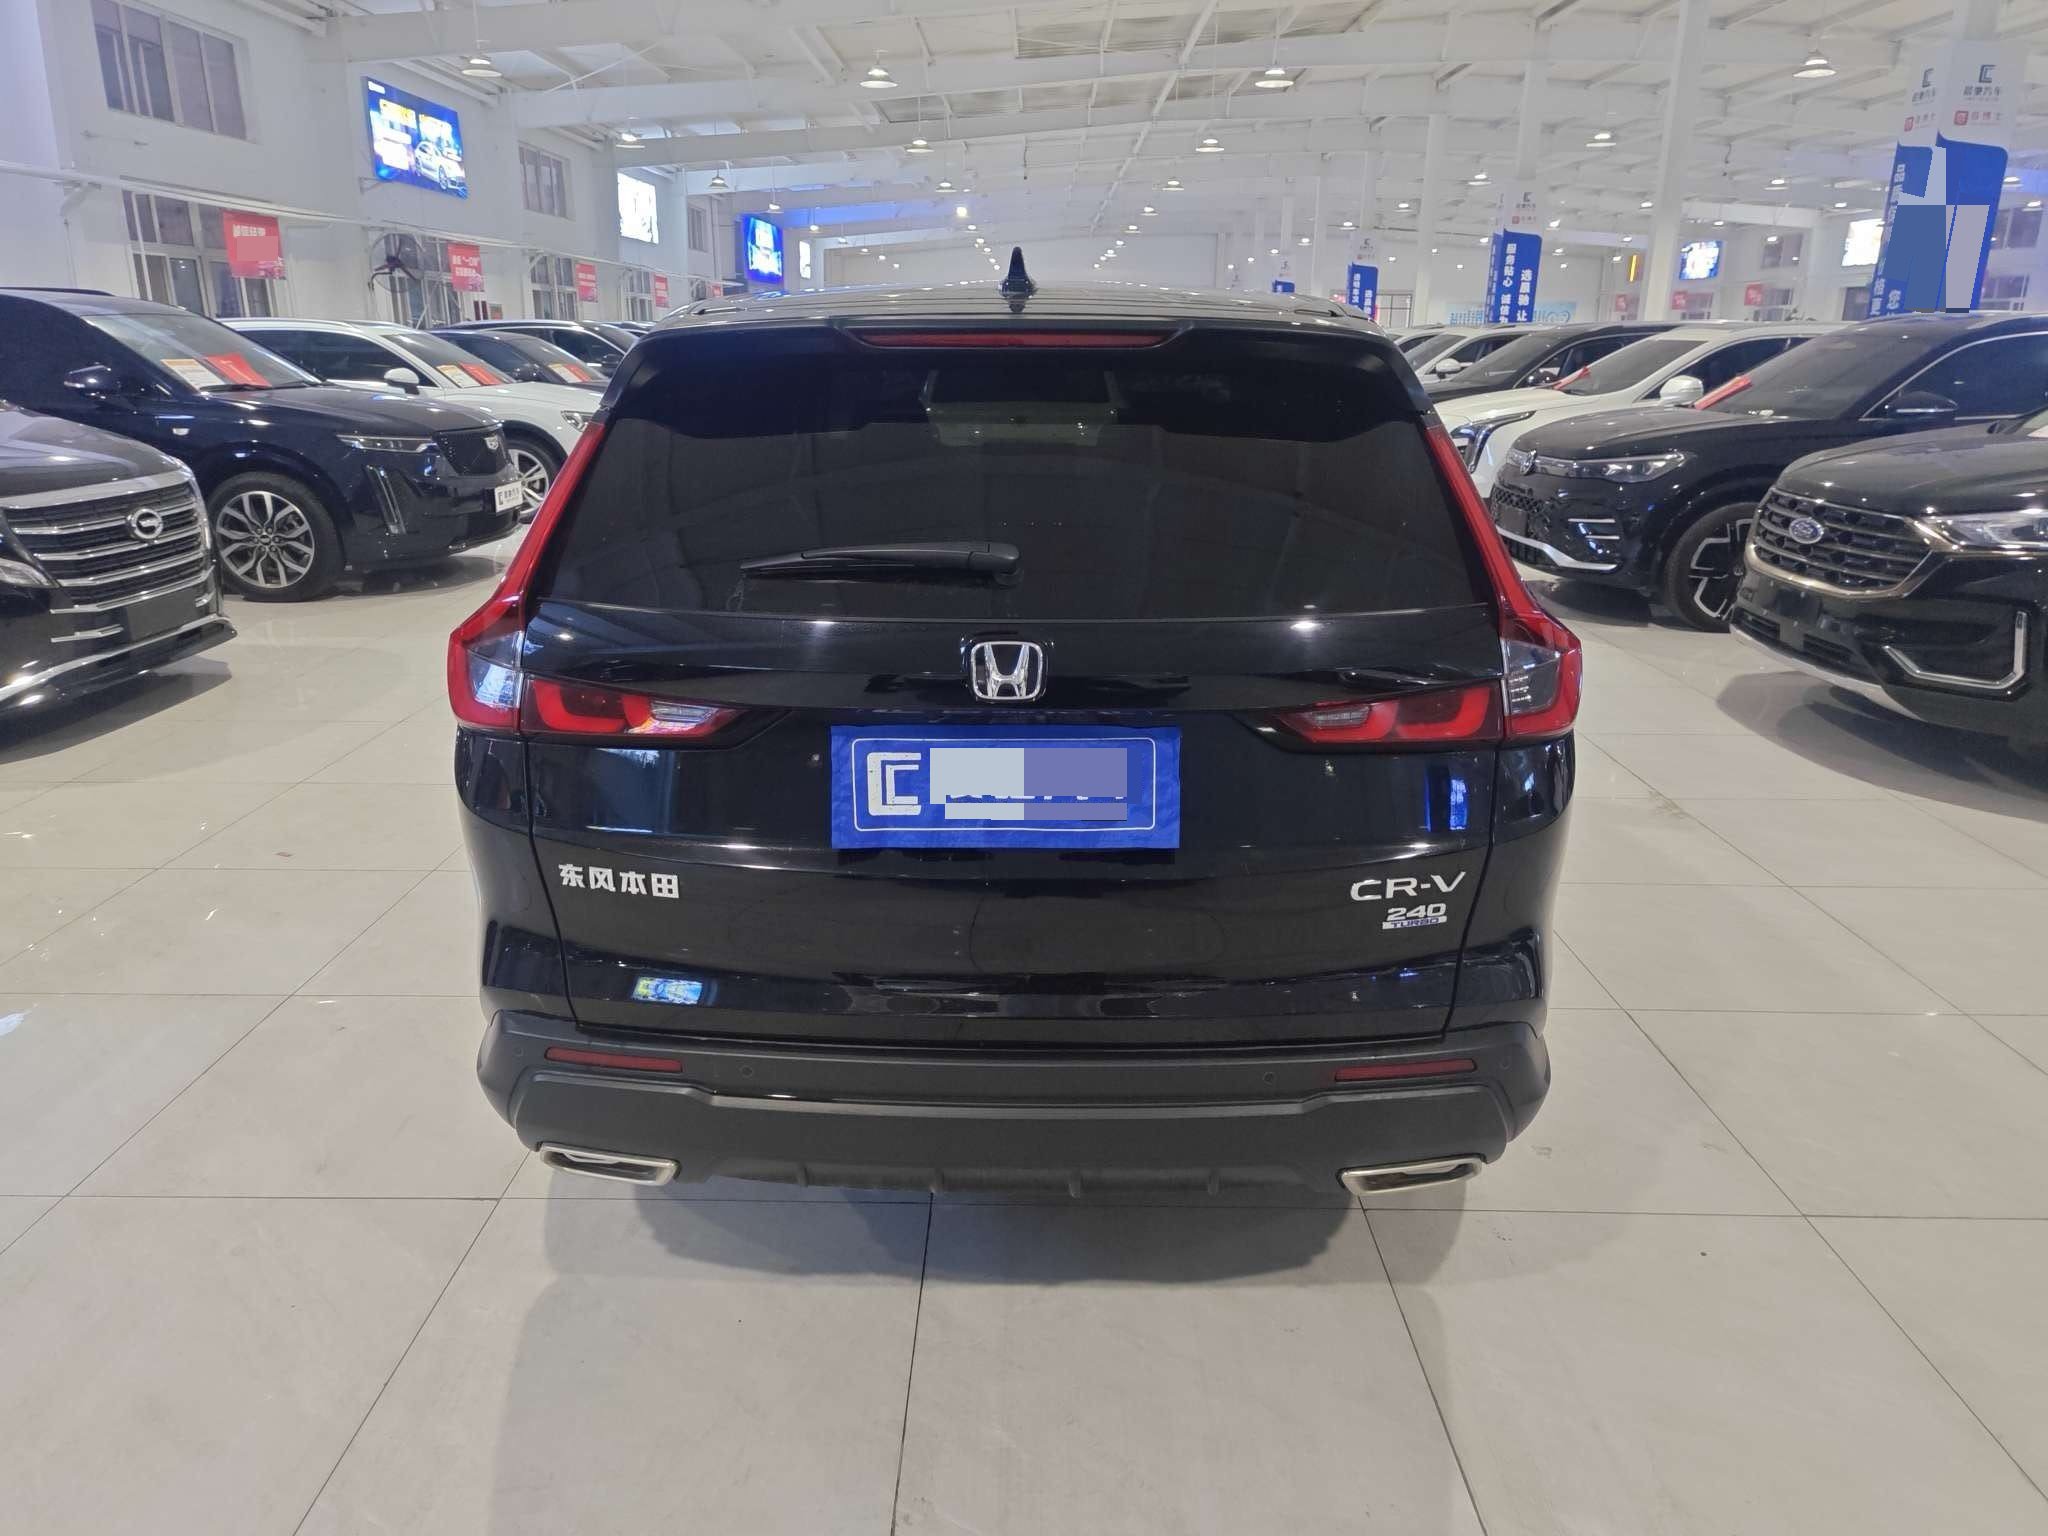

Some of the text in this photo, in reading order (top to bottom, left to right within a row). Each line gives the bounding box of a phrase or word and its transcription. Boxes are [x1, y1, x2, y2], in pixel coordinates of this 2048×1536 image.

[558, 863, 680, 899] 东风本田
[1350, 871, 1467, 902] CR-V
[1386, 902, 1447, 922] 240
[1388, 915, 1443, 929] TURBO
